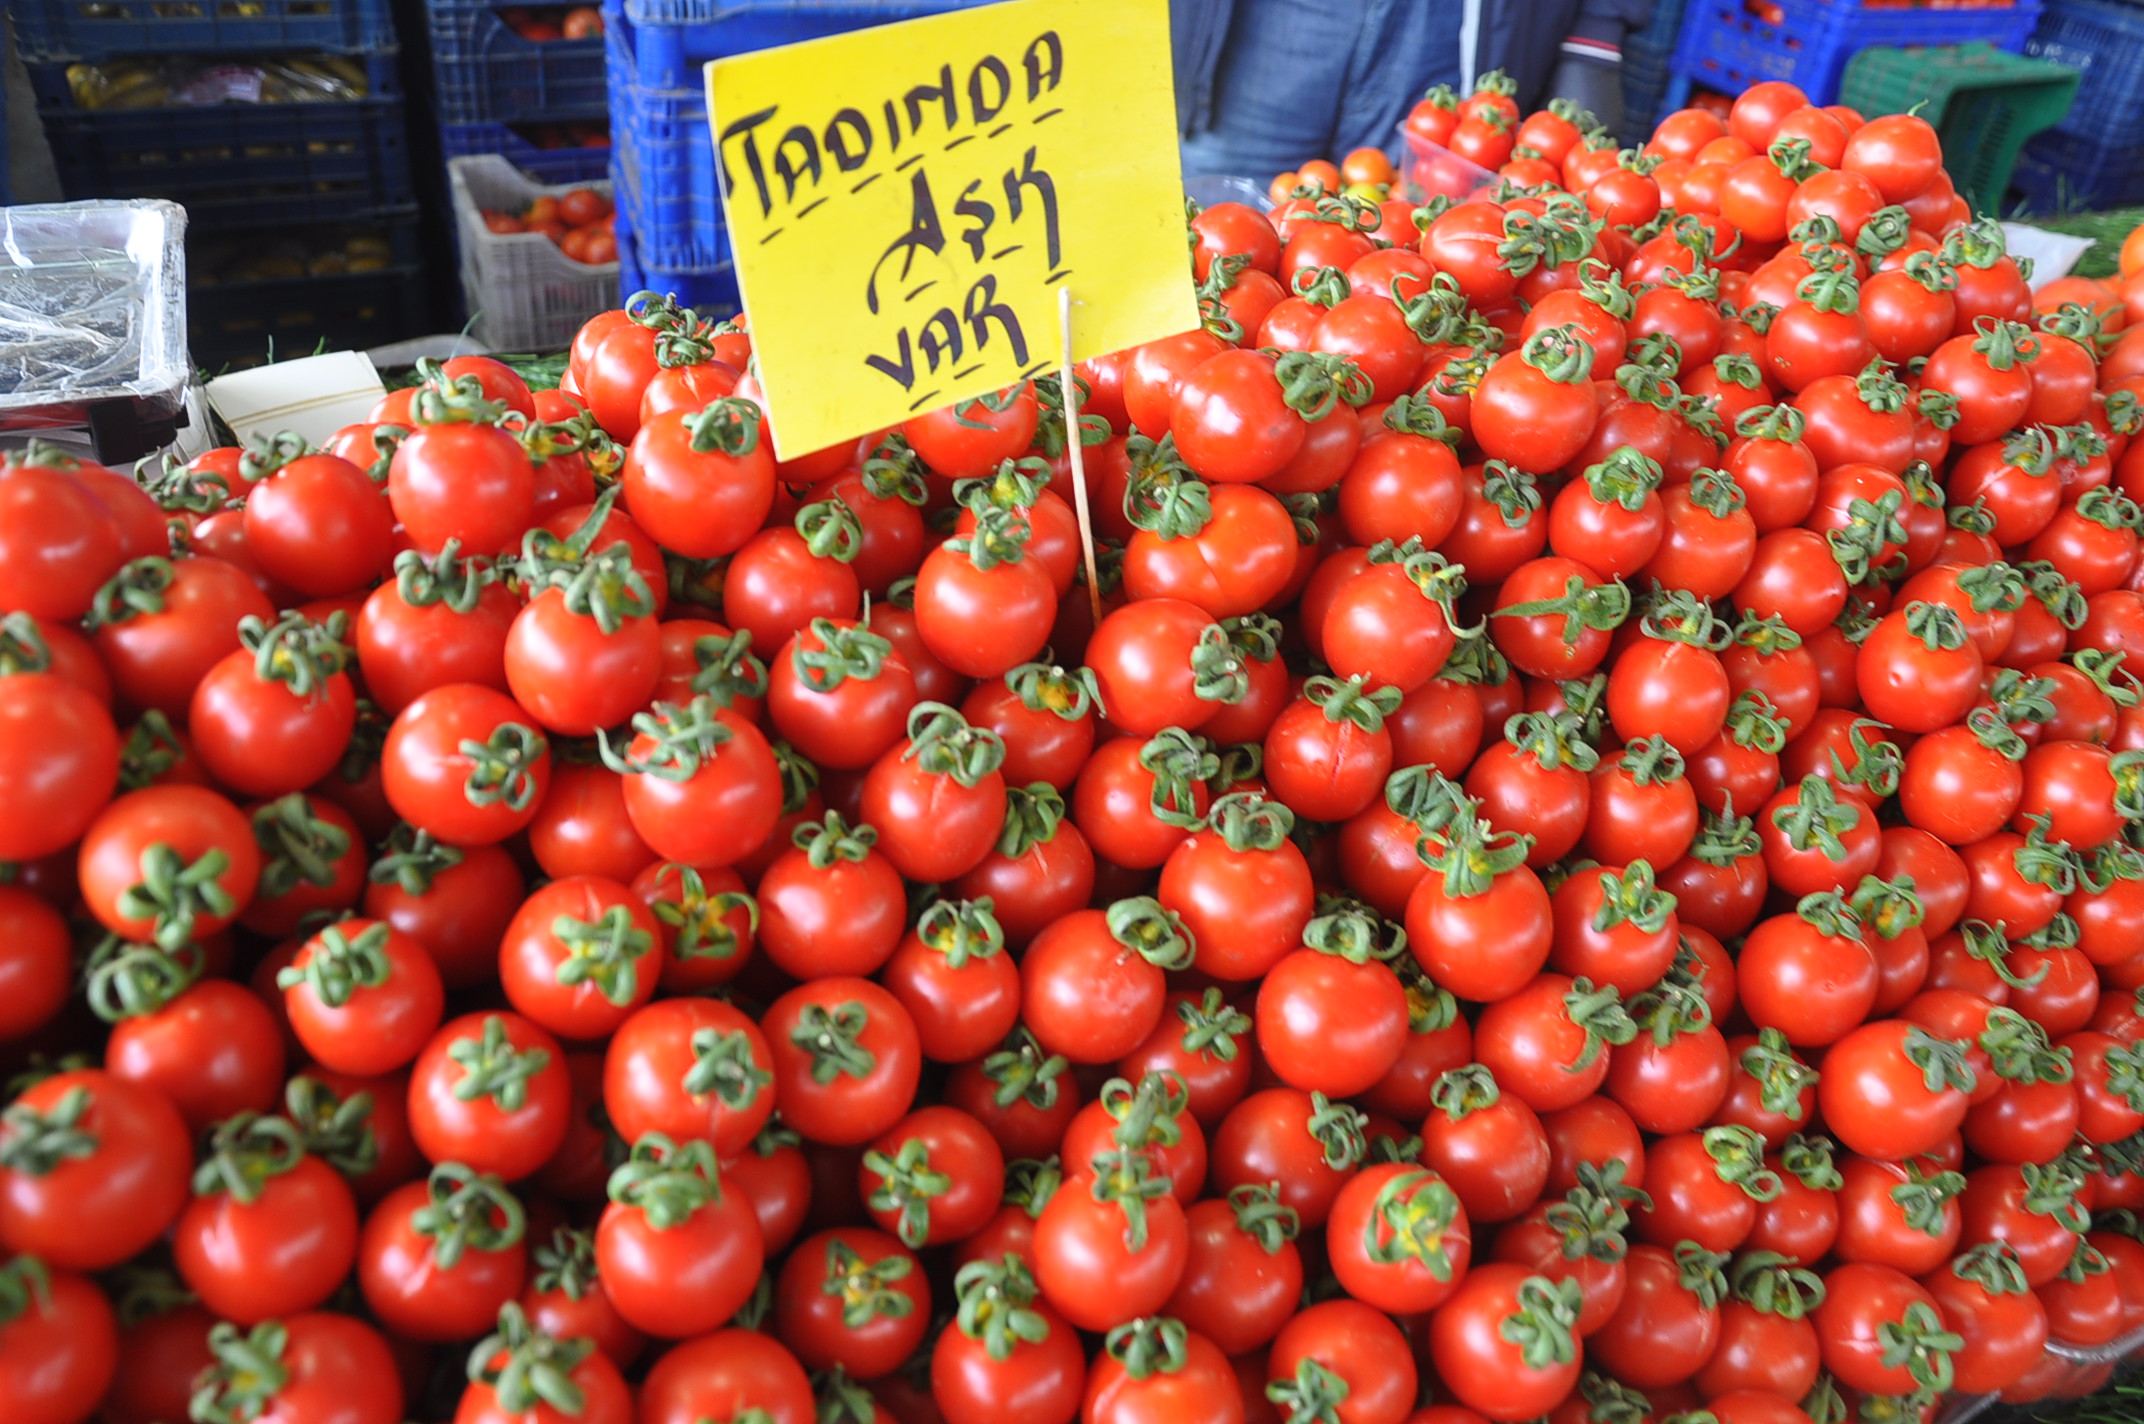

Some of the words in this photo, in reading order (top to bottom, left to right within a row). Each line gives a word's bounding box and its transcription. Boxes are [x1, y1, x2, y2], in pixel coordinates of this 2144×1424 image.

[719, 30, 1064, 220] TADINDA
[866, 145, 1061, 315] AŞK
[864, 273, 1030, 392] VAR
